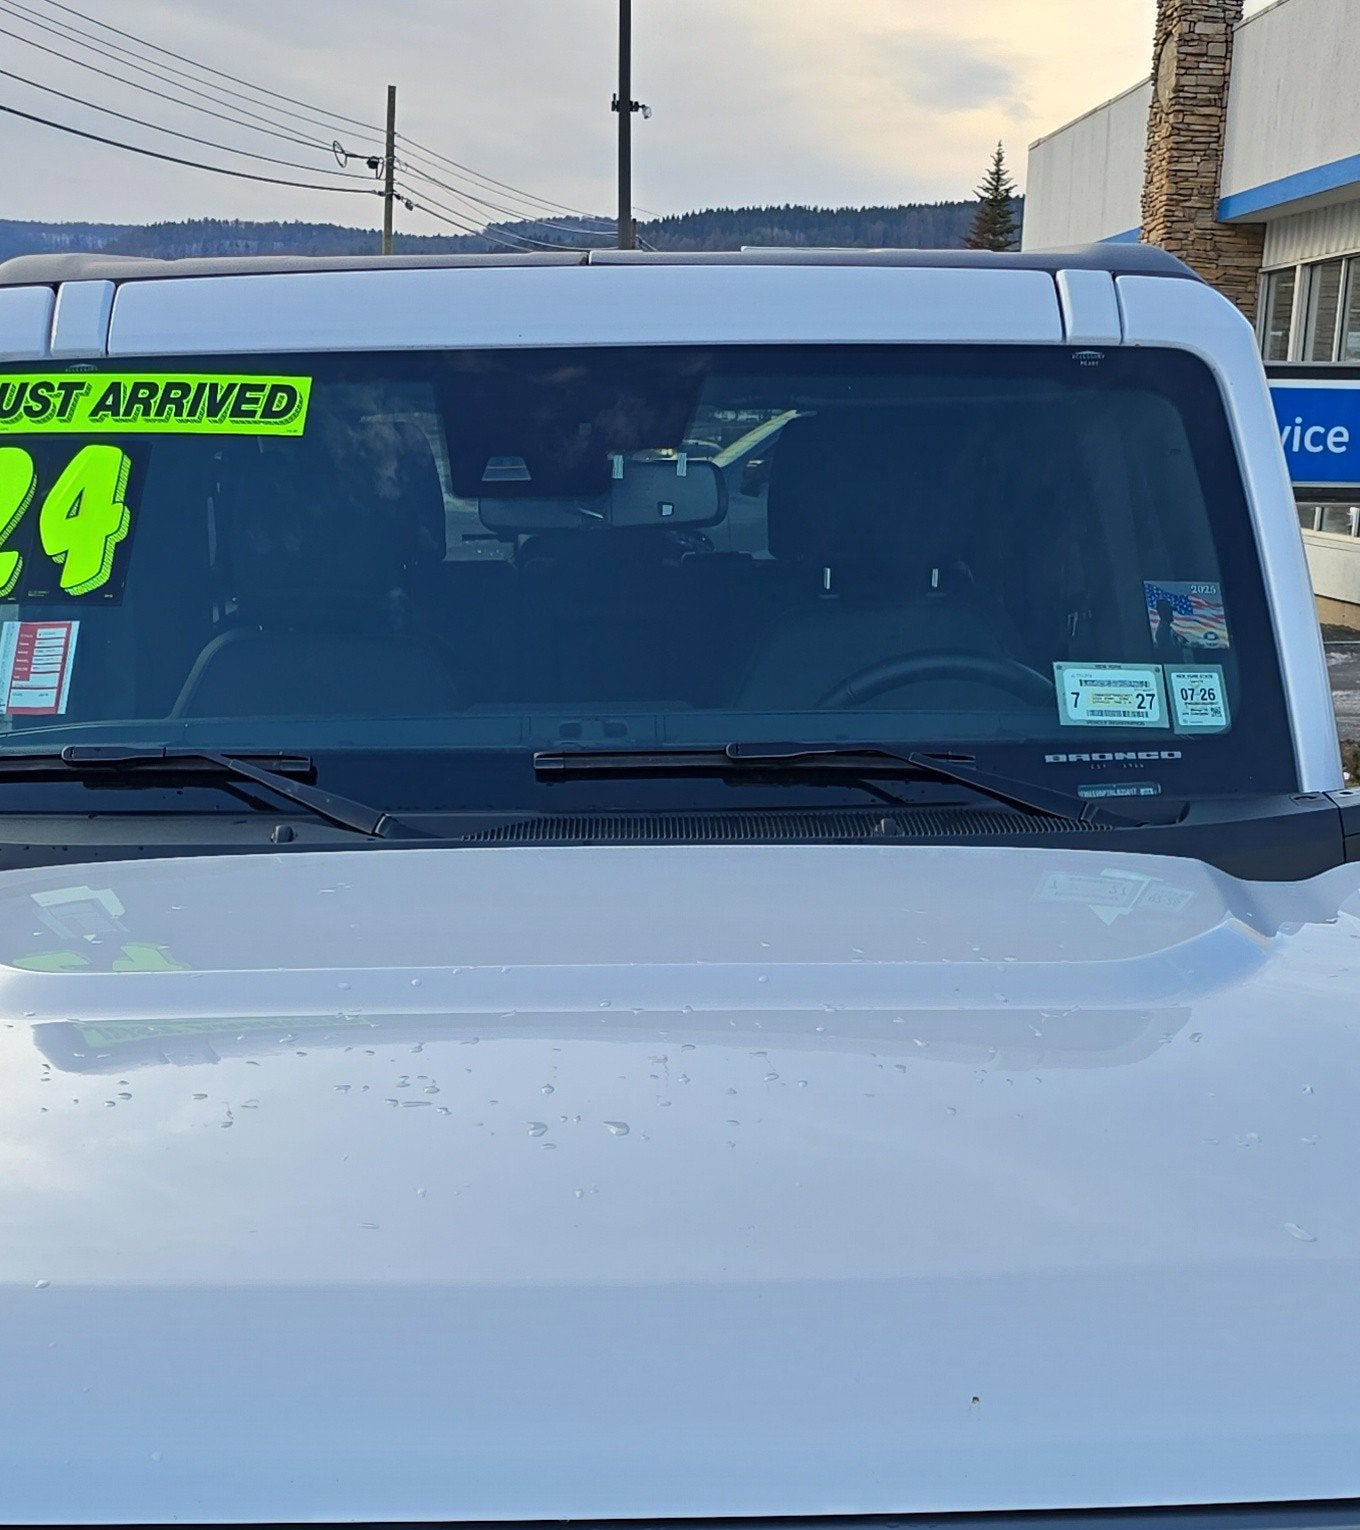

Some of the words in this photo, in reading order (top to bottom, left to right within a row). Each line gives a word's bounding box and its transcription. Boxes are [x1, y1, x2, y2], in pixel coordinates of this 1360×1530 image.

[89, 381, 303, 424] ARRIVED
[1071, 692, 1080, 708] 7
[1135, 693, 1156, 710] 27
[1044, 751, 1182, 763] BRONCO
